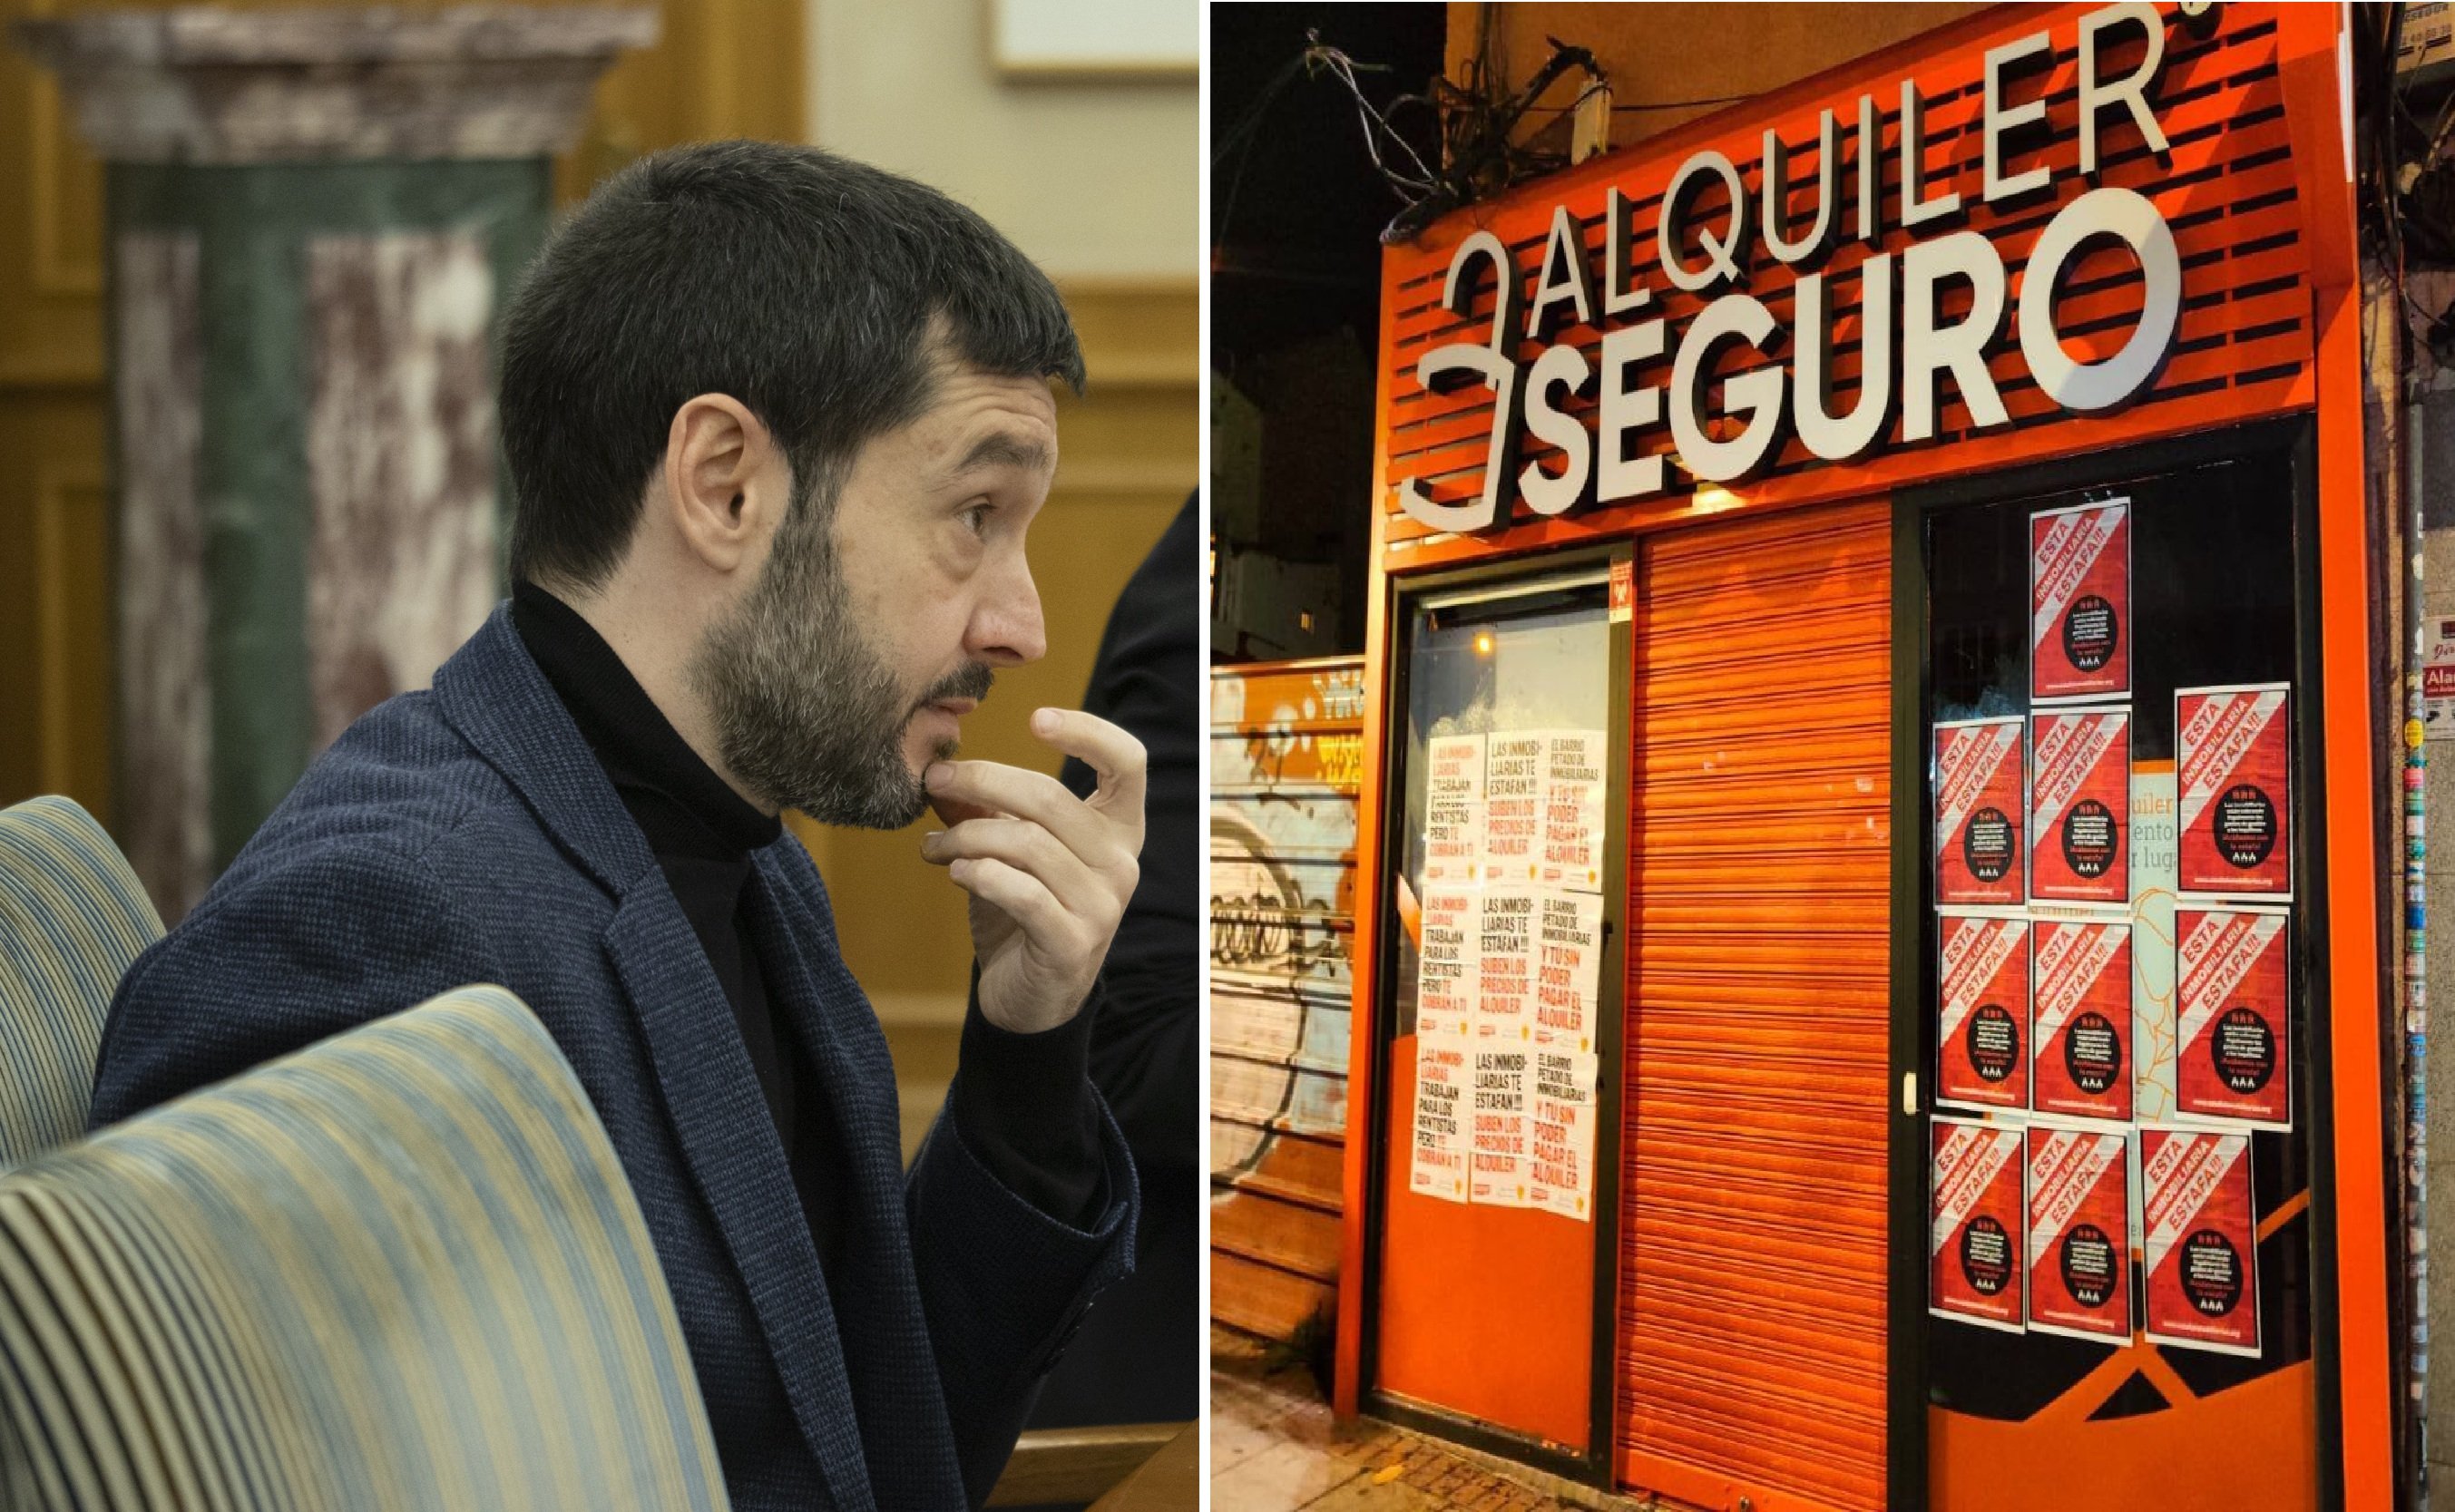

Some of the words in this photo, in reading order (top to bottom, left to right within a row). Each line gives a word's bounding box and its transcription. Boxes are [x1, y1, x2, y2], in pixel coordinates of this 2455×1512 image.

[1528, 2, 2170, 339] ALQUILER
[1518, 188, 2179, 515] SEGURO
[2039, 522, 2069, 564] ESTA
[2427, 668, 2455, 685] Ala
[2185, 704, 2220, 746] ESTA
[1492, 742, 1506, 756] LAS
[2039, 724, 2070, 763] ESTA
[1941, 735, 1971, 774] ESTA
[1492, 760, 1522, 776] LIARIAS
[1490, 779, 1526, 795] ESTAFAN
[2132, 793, 2174, 815] uiler
[1547, 805, 1579, 823] PODER
[2134, 824, 2174, 841] ento
[2144, 846, 2176, 872] lug
[1483, 897, 1498, 914] LAS
[1501, 897, 1533, 913] INMOBI-
[1482, 917, 1515, 933] LIARIAS
[1542, 913, 1568, 926] PETADO
[1426, 929, 1463, 944] TRABAJAN
[1481, 935, 1518, 952] ESTAFAN
[1945, 926, 1974, 964] ESTA
[2183, 921, 2219, 964] ESTA
[1424, 945, 1443, 959] PARA
[2040, 931, 2072, 971] ESTA
[1511, 958, 1526, 975] LOS
[1476, 1053, 1492, 1070] LAS
[1493, 1053, 1527, 1070] INMOBI-
[1475, 1073, 1509, 1088] LIARIAS
[1538, 1068, 1563, 1083] PETADO
[1421, 1081, 1459, 1100] TRABAJAN
[1419, 1097, 1437, 1114] PARA
[1439, 1100, 1452, 1117] LOS
[1475, 1092, 1512, 1109] ESTAFAN
[1418, 1115, 1456, 1135] RENTISTAS
[1505, 1117, 1521, 1133] LOS
[1937, 1134, 1967, 1172] ESTA
[2034, 1138, 2066, 1179] ESTA
[2149, 1139, 2183, 1184] ESTA
